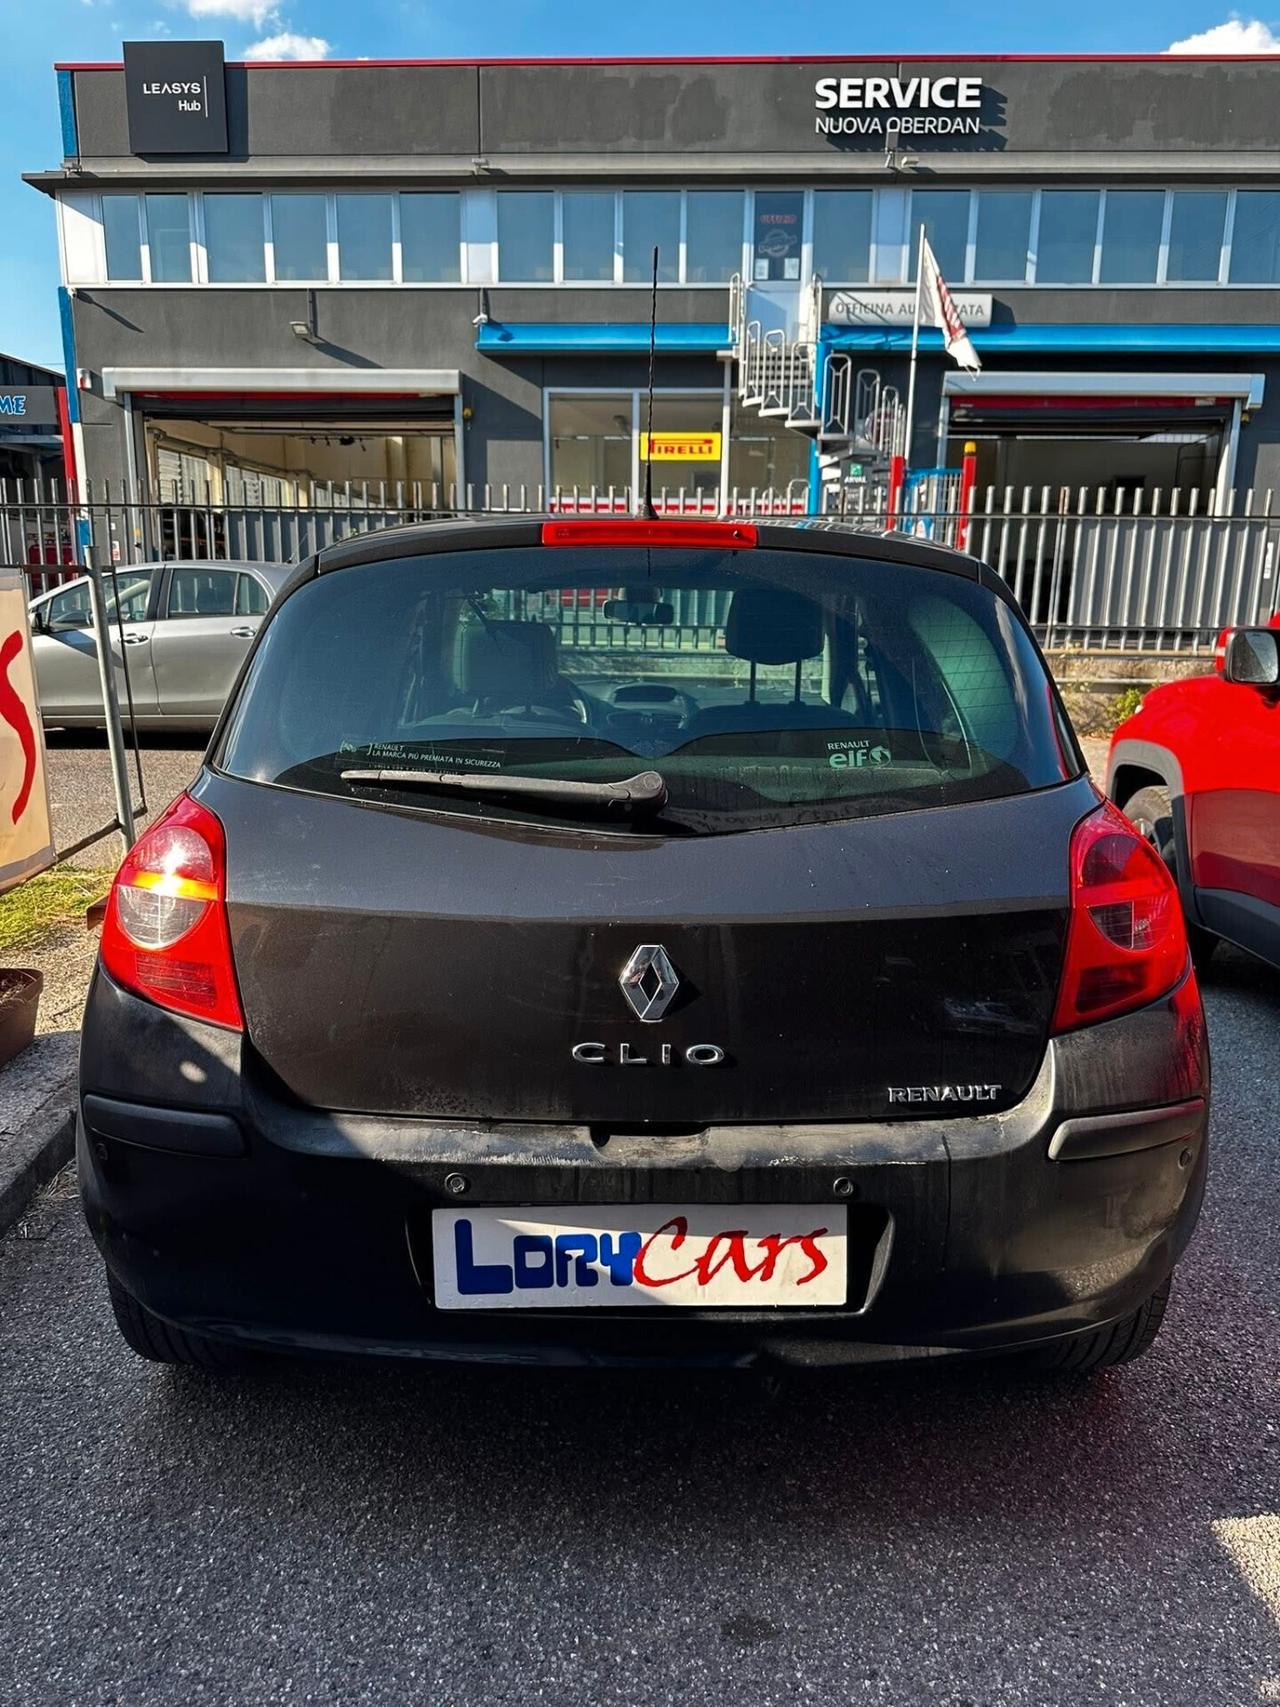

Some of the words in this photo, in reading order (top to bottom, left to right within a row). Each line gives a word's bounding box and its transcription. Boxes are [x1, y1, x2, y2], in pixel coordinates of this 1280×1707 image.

[143, 83, 201, 94] LEASYS
[815, 77, 983, 109] SERVICE
[178, 100, 201, 111] Hub
[815, 117, 883, 134] NUOVA
[886, 117, 980, 134] OBERDAN
[835, 302, 894, 314] OFFICINA
[373, 743, 405, 751] RENAULT
[827, 740, 870, 750] RENAULT
[382, 751, 406, 759] MARCA
[420, 753, 454, 764] PREMIATA
[455, 756, 463, 765] IN
[464, 758, 501, 769] SICUREZZA
[829, 749, 867, 769] elf
[572, 1042, 725, 1065] CLIO
[888, 1084, 1002, 1103] RENAULT
